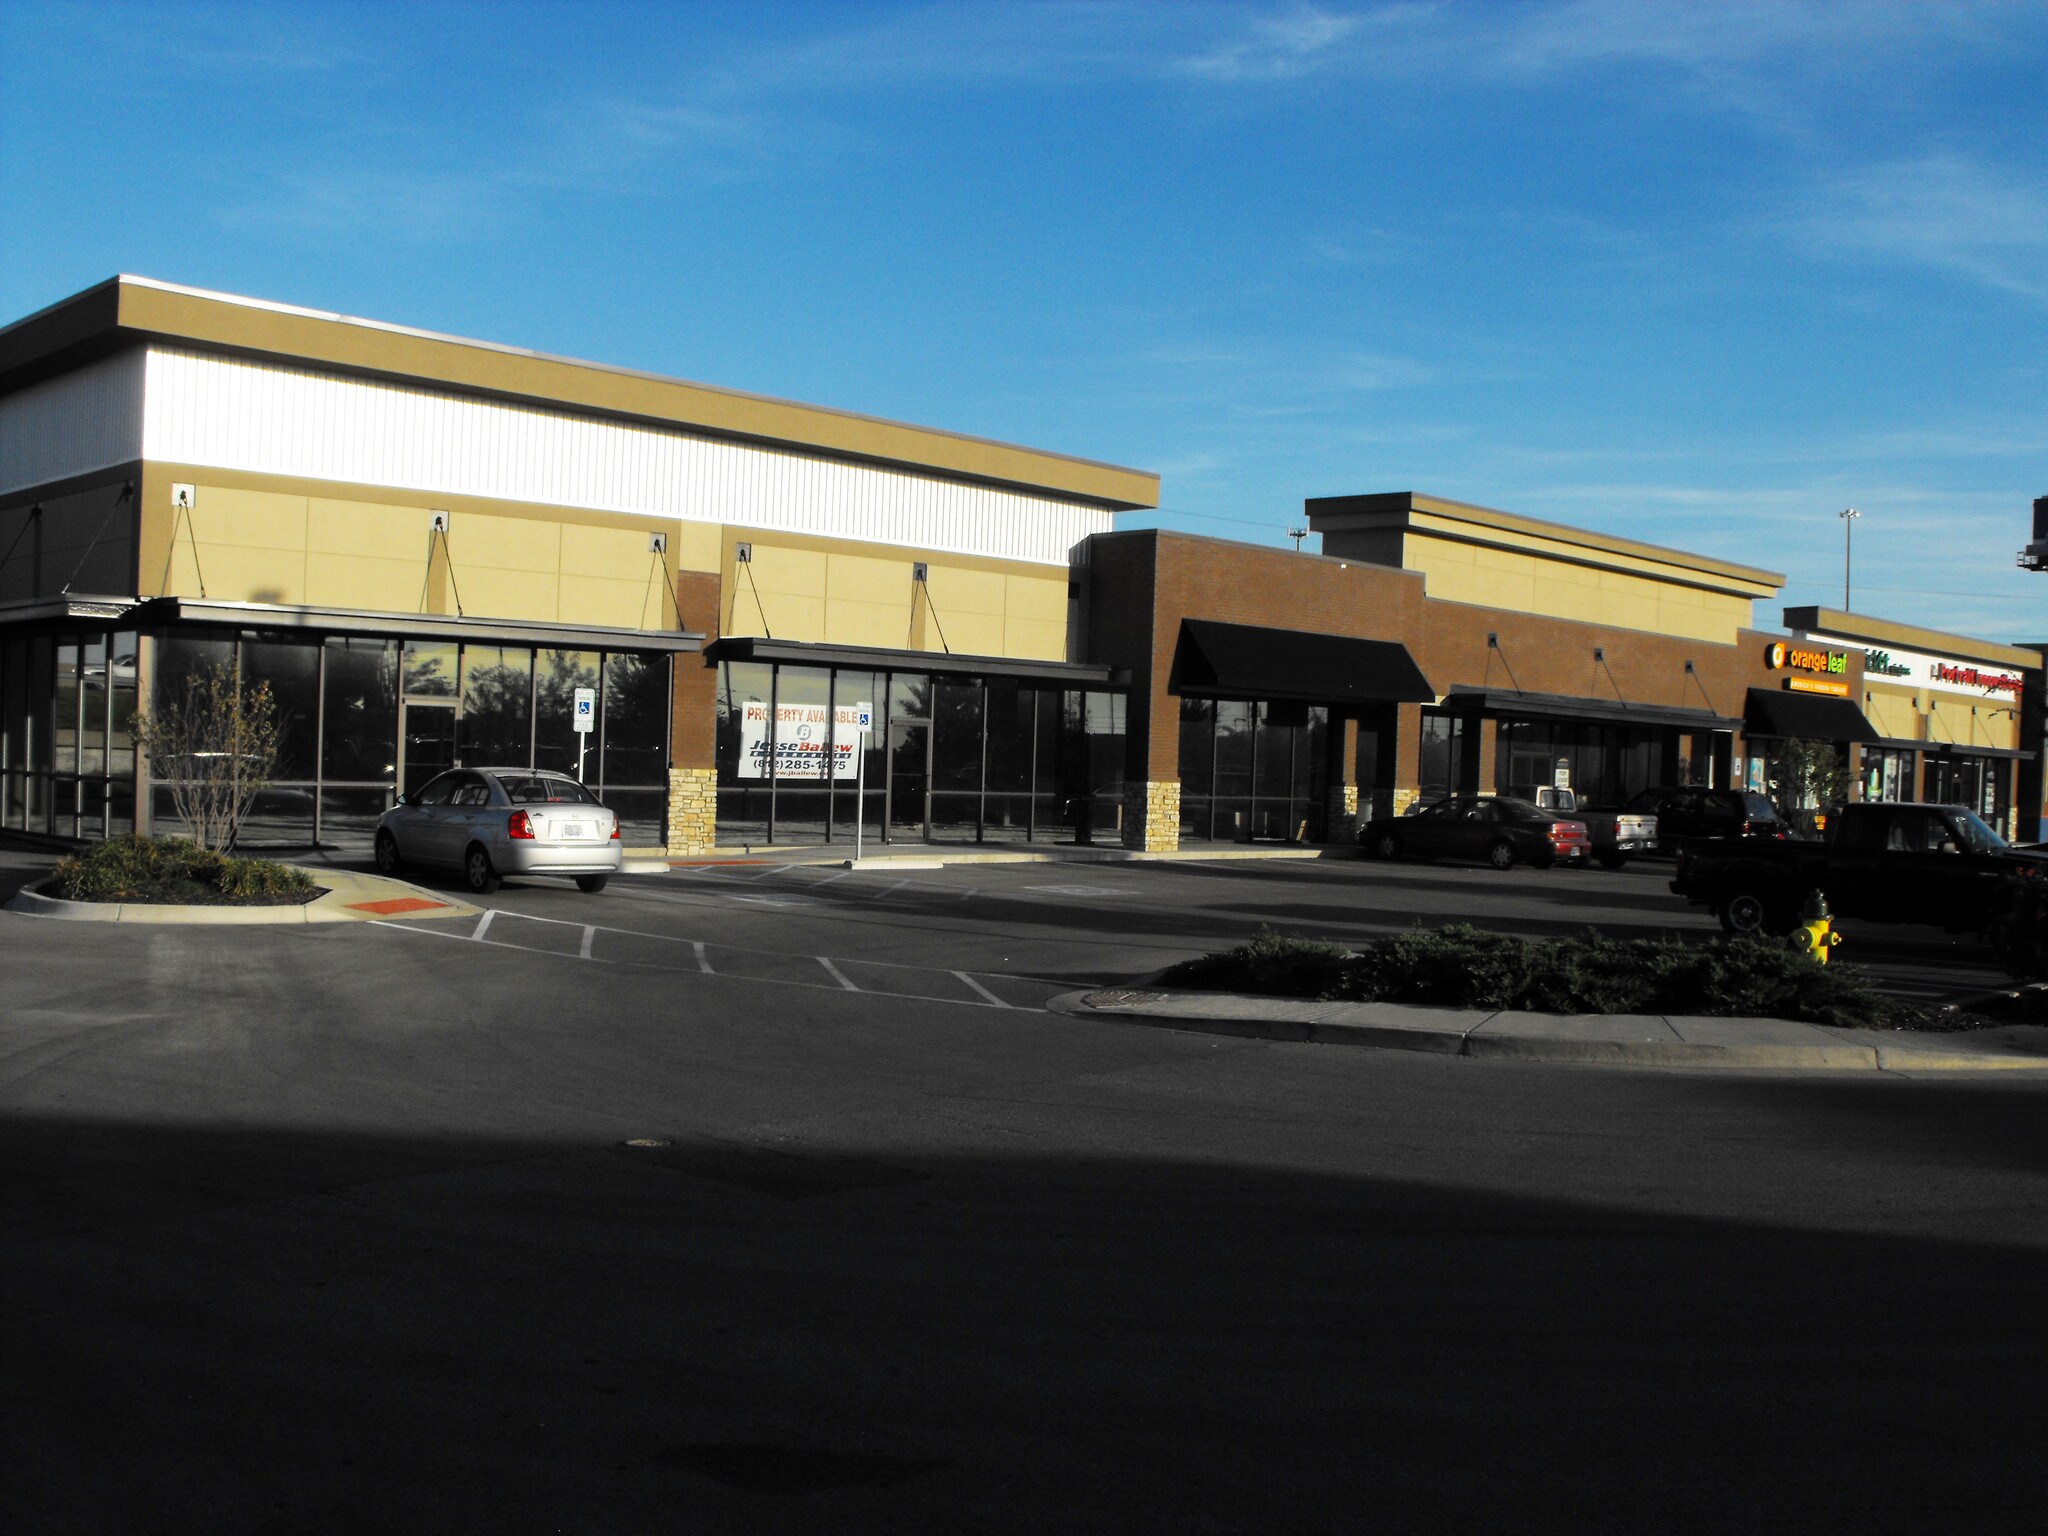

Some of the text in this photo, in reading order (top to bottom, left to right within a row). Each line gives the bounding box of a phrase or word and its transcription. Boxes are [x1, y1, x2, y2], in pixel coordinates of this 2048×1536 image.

[1791, 650, 1847, 673] orange leaf
[747, 706, 857, 724] PROERTY AVAABLE
